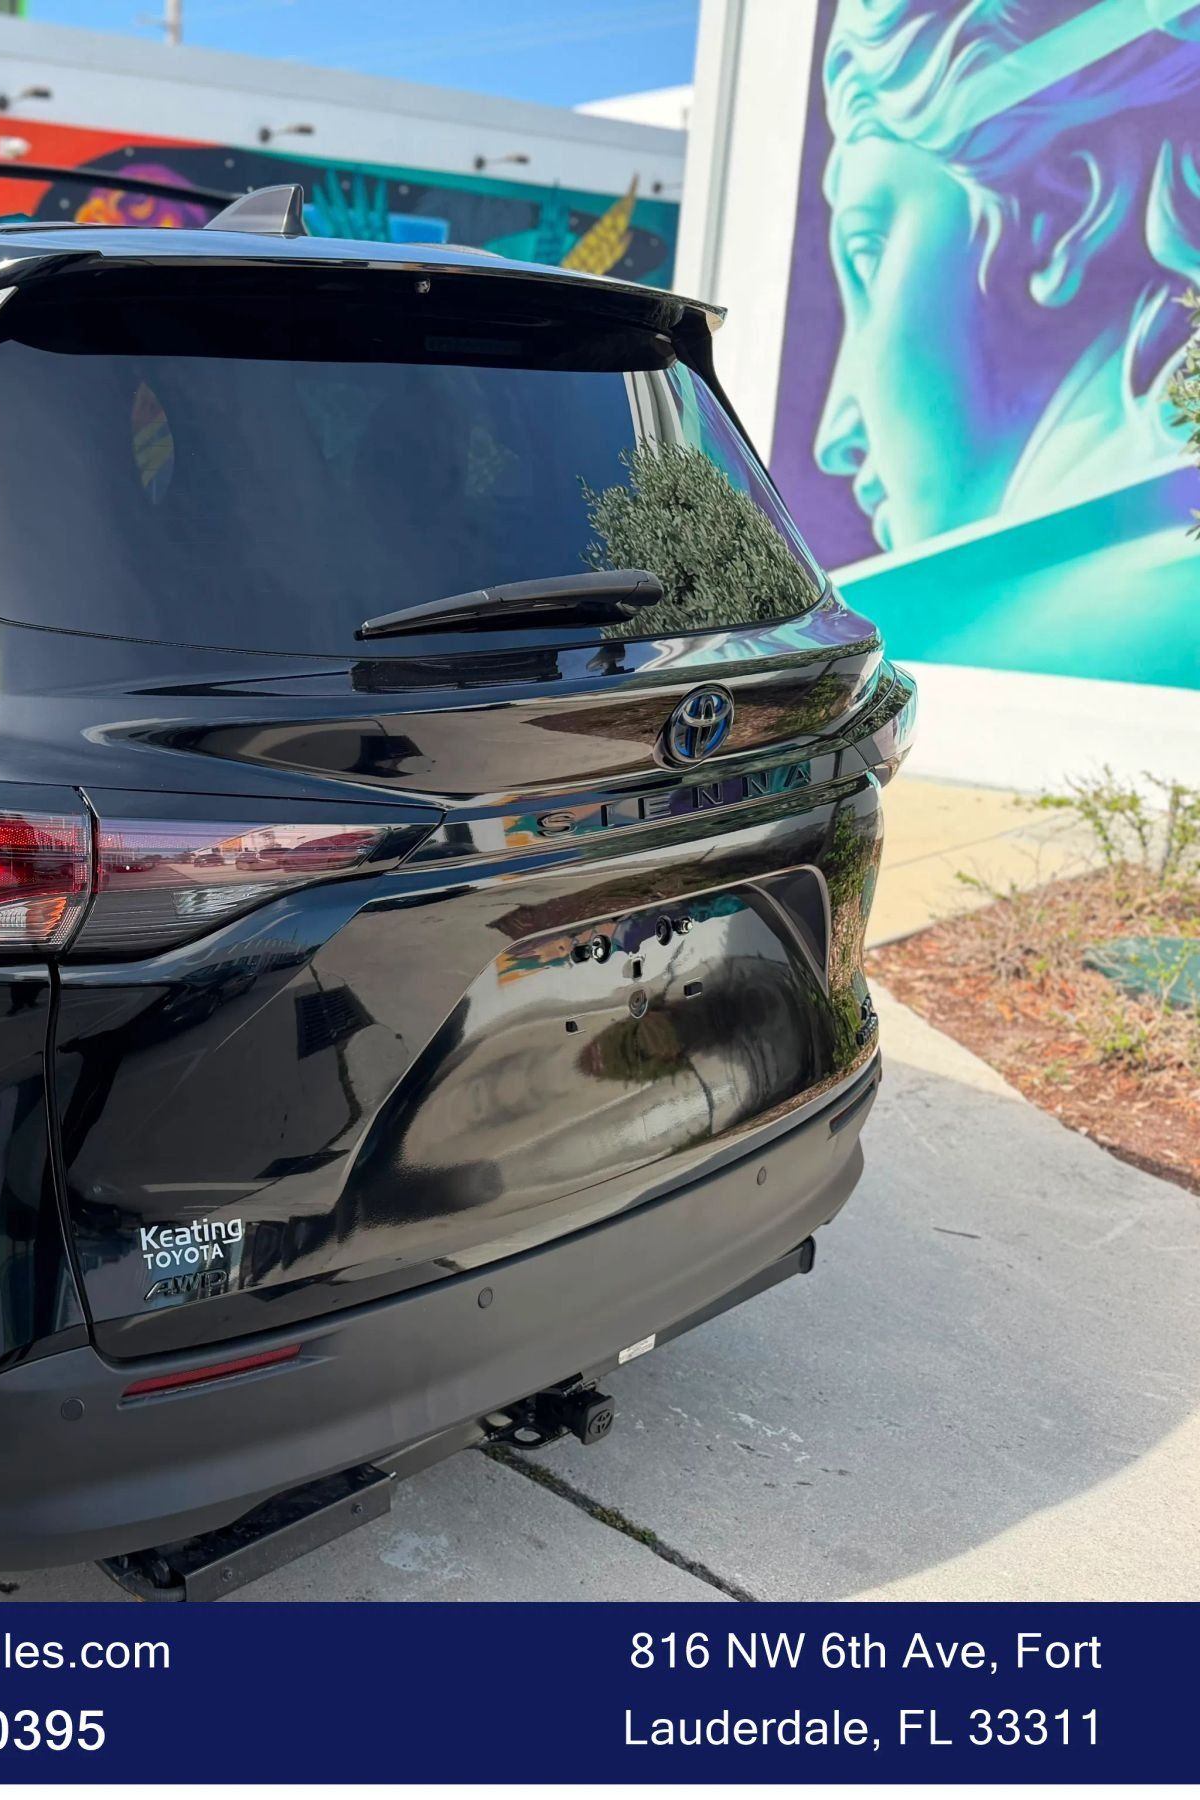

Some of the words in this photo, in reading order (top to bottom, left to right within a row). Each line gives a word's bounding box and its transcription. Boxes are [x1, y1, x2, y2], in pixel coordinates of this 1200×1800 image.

[537, 766, 811, 837] SIENNA
[140, 1218, 242, 1251] Keating
[143, 1243, 224, 1270] TOYOTA
[144, 1268, 228, 1300] AWD
